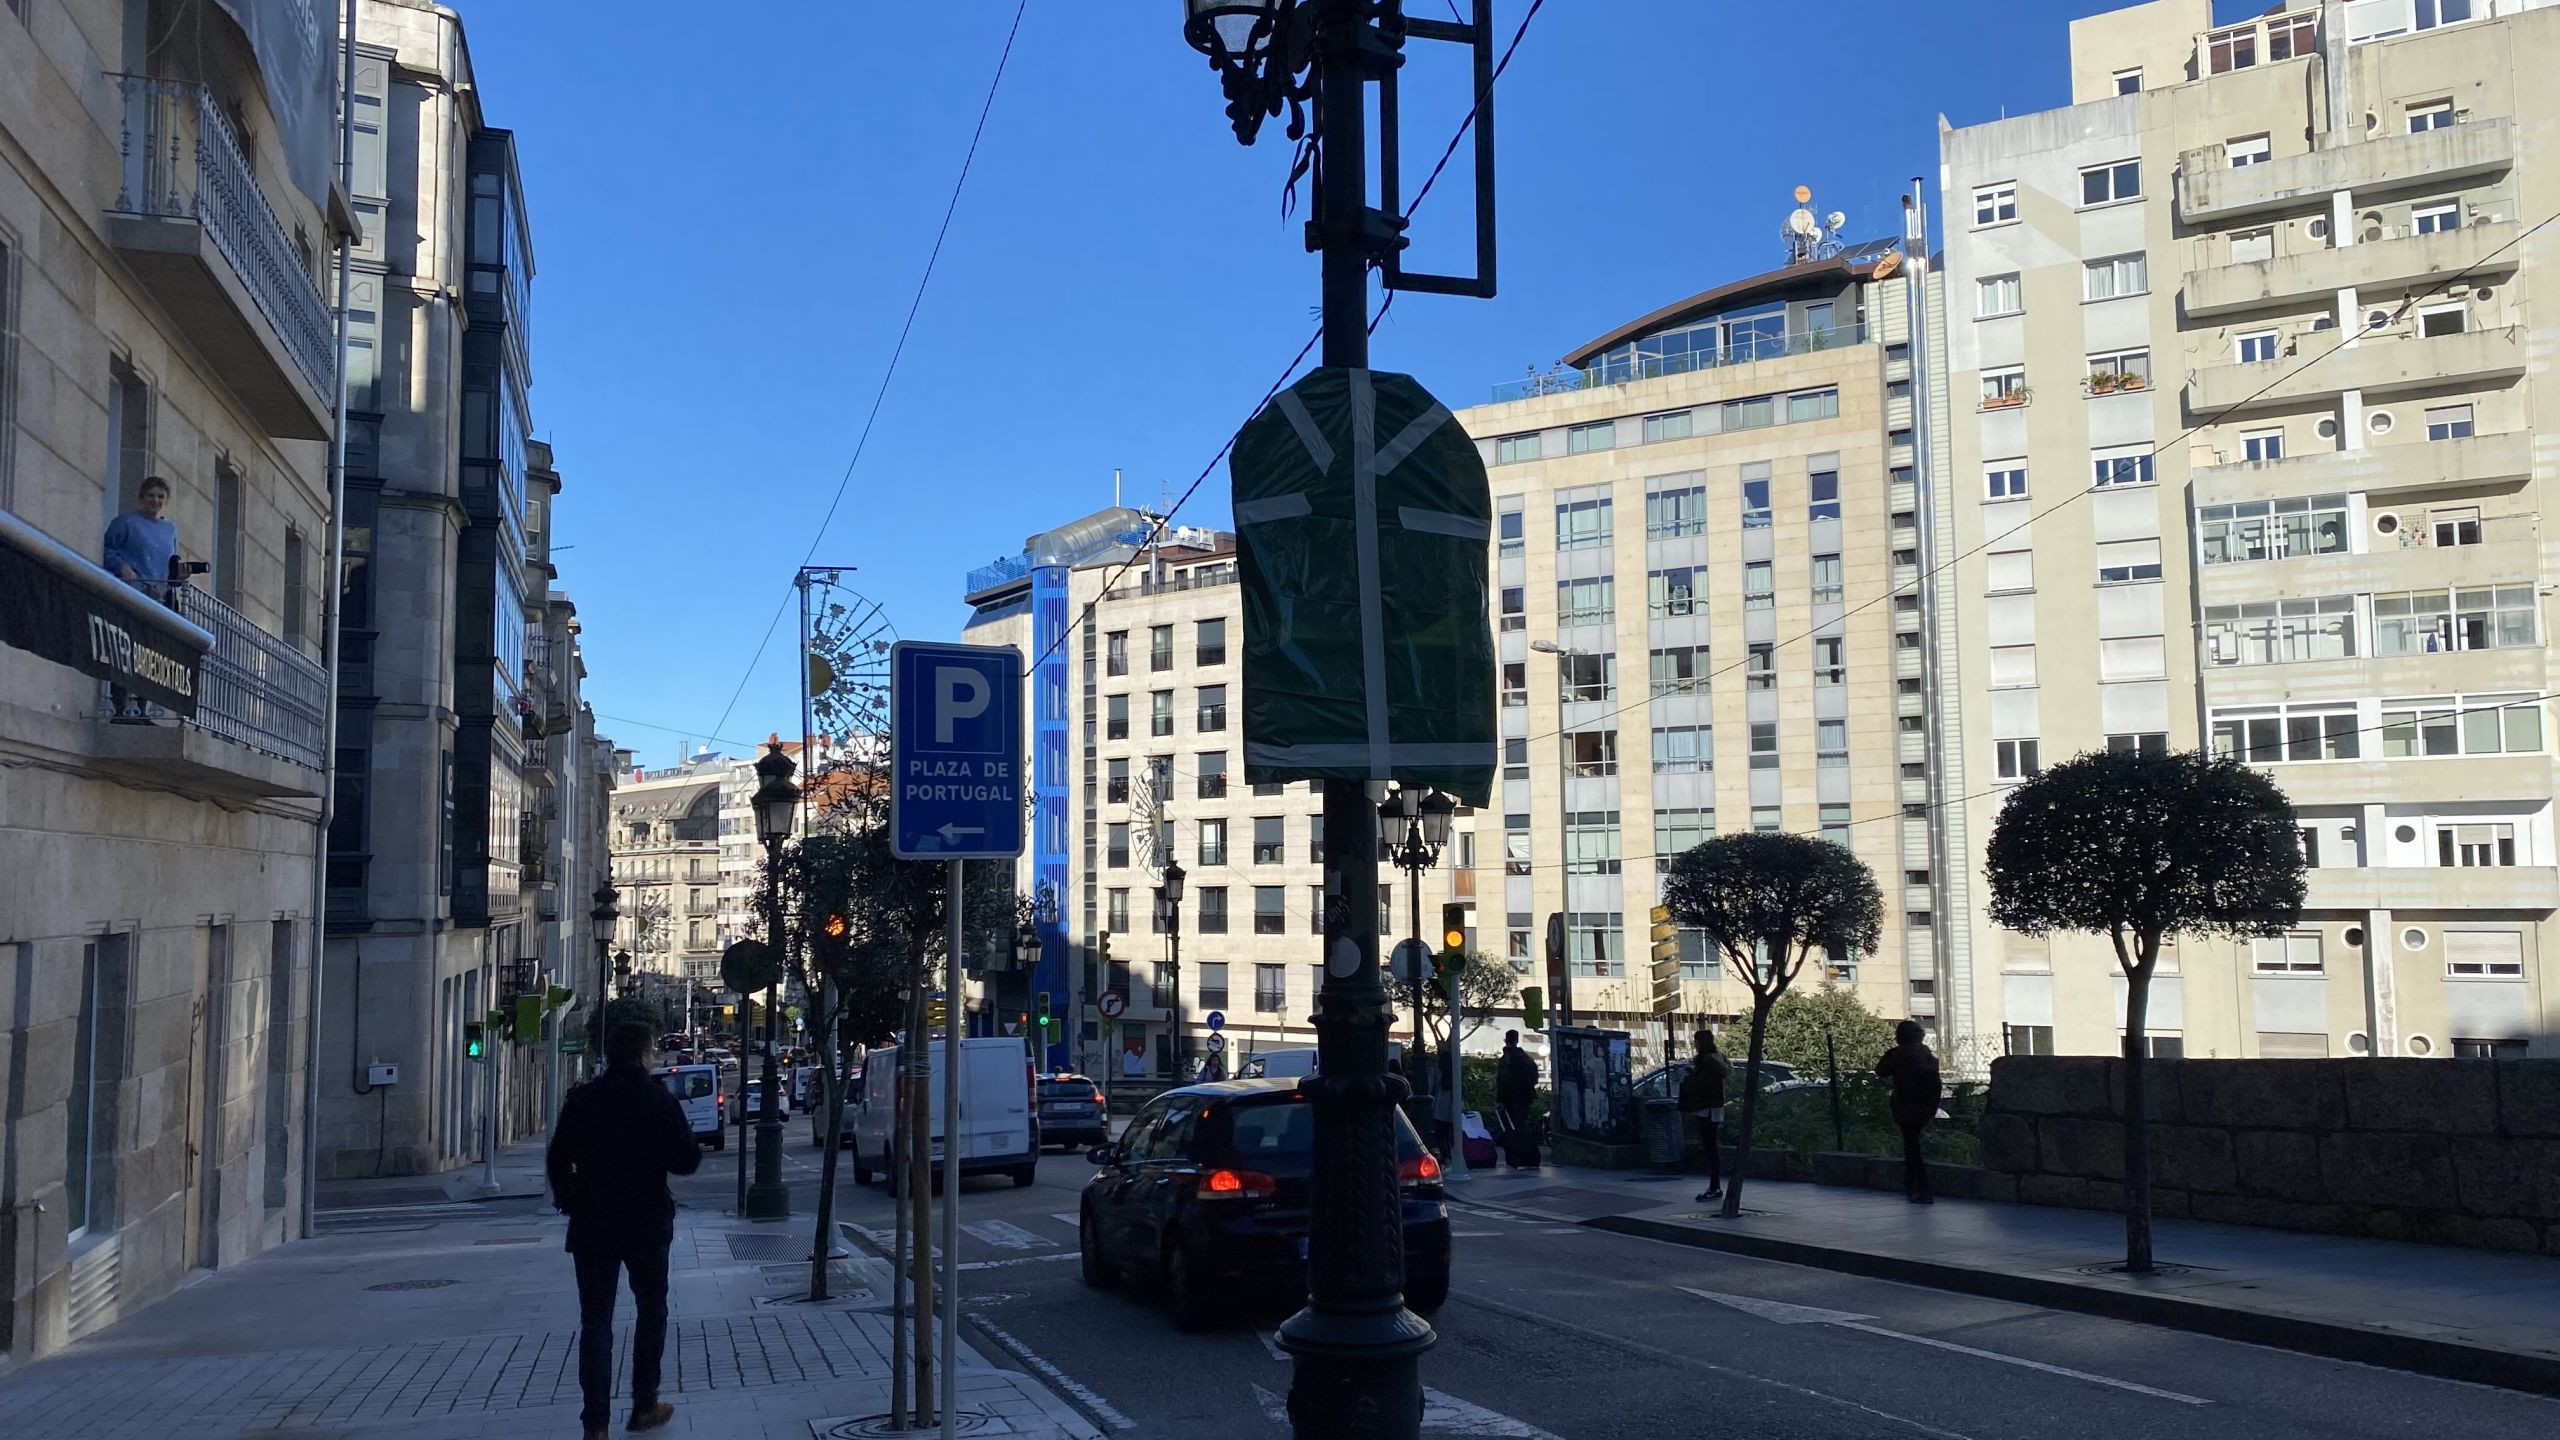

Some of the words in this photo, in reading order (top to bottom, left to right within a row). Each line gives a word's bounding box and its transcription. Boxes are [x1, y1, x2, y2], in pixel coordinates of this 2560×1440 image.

[935, 666, 991, 744] P
[909, 760, 971, 777] PLAZA
[984, 762, 1009, 778] DE
[906, 784, 1013, 801] PORTUGAL
